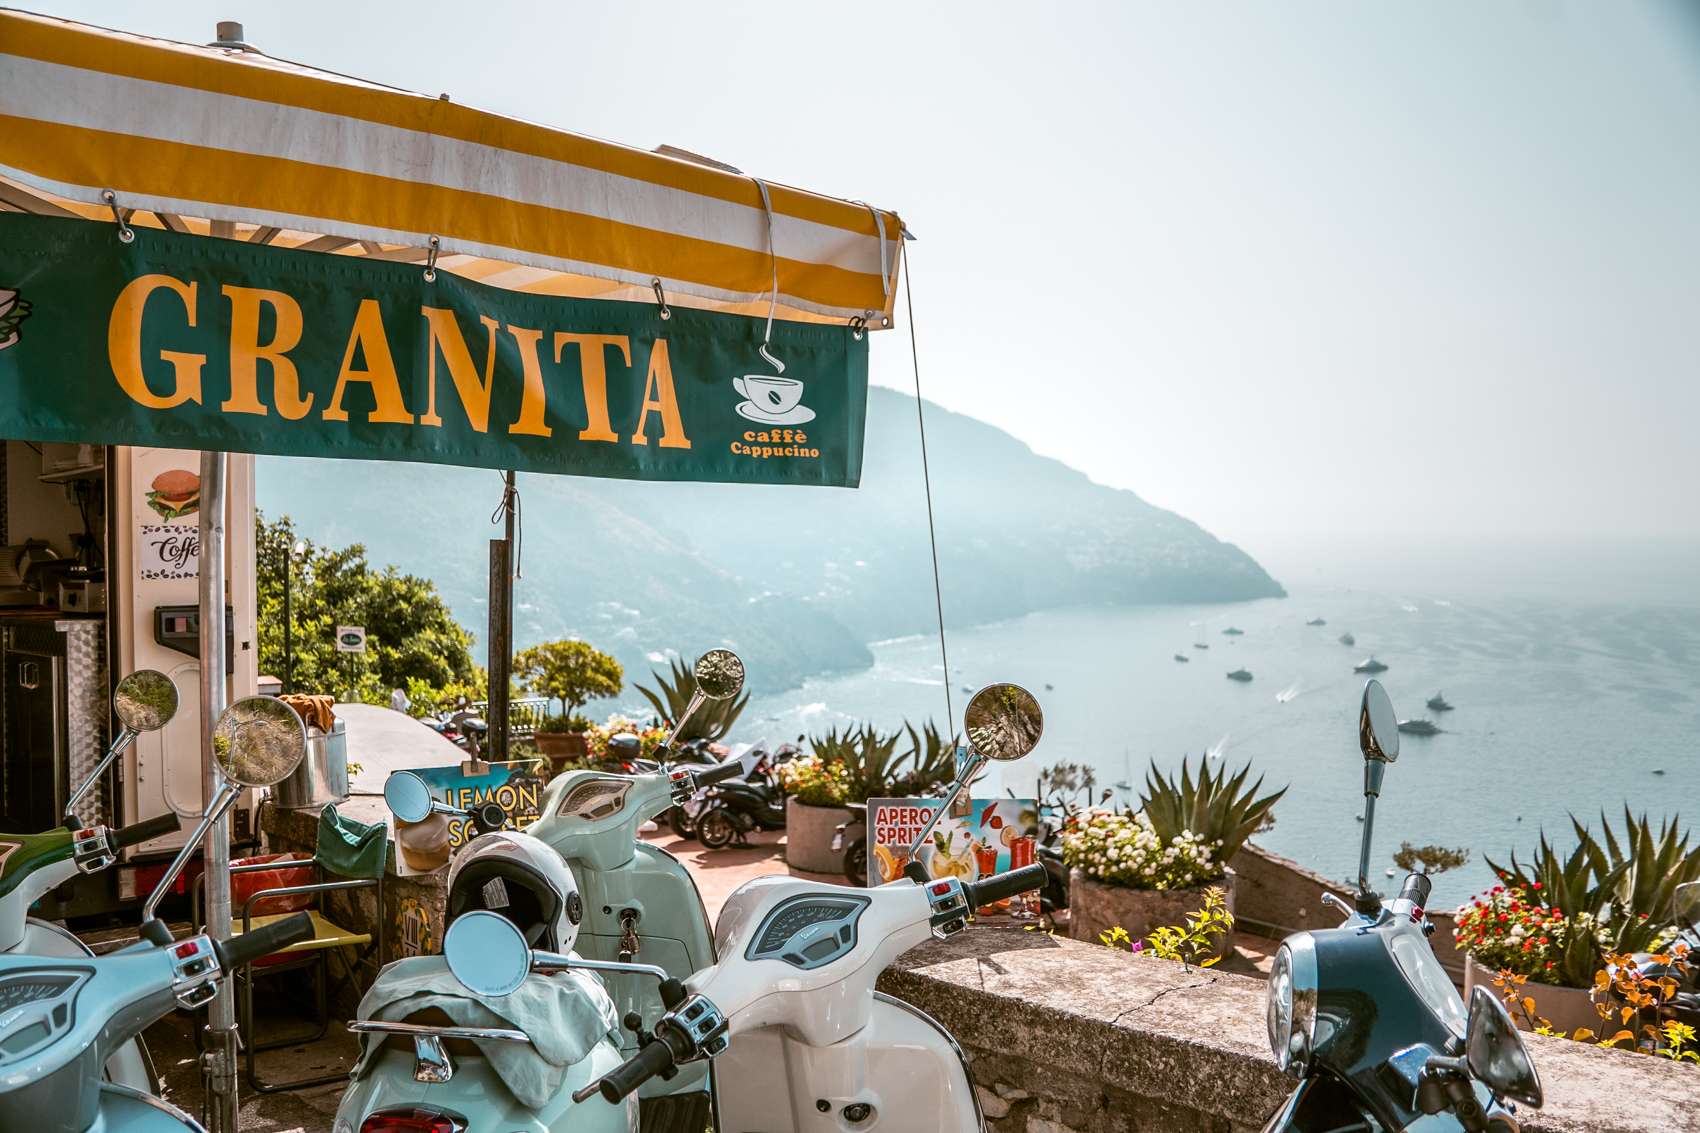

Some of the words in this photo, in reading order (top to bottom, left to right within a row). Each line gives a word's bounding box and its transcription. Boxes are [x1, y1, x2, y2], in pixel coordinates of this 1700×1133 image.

[108, 273, 692, 450] GRANITA
[743, 428, 808, 443] caffè
[730, 441, 820, 459] Cappucino
